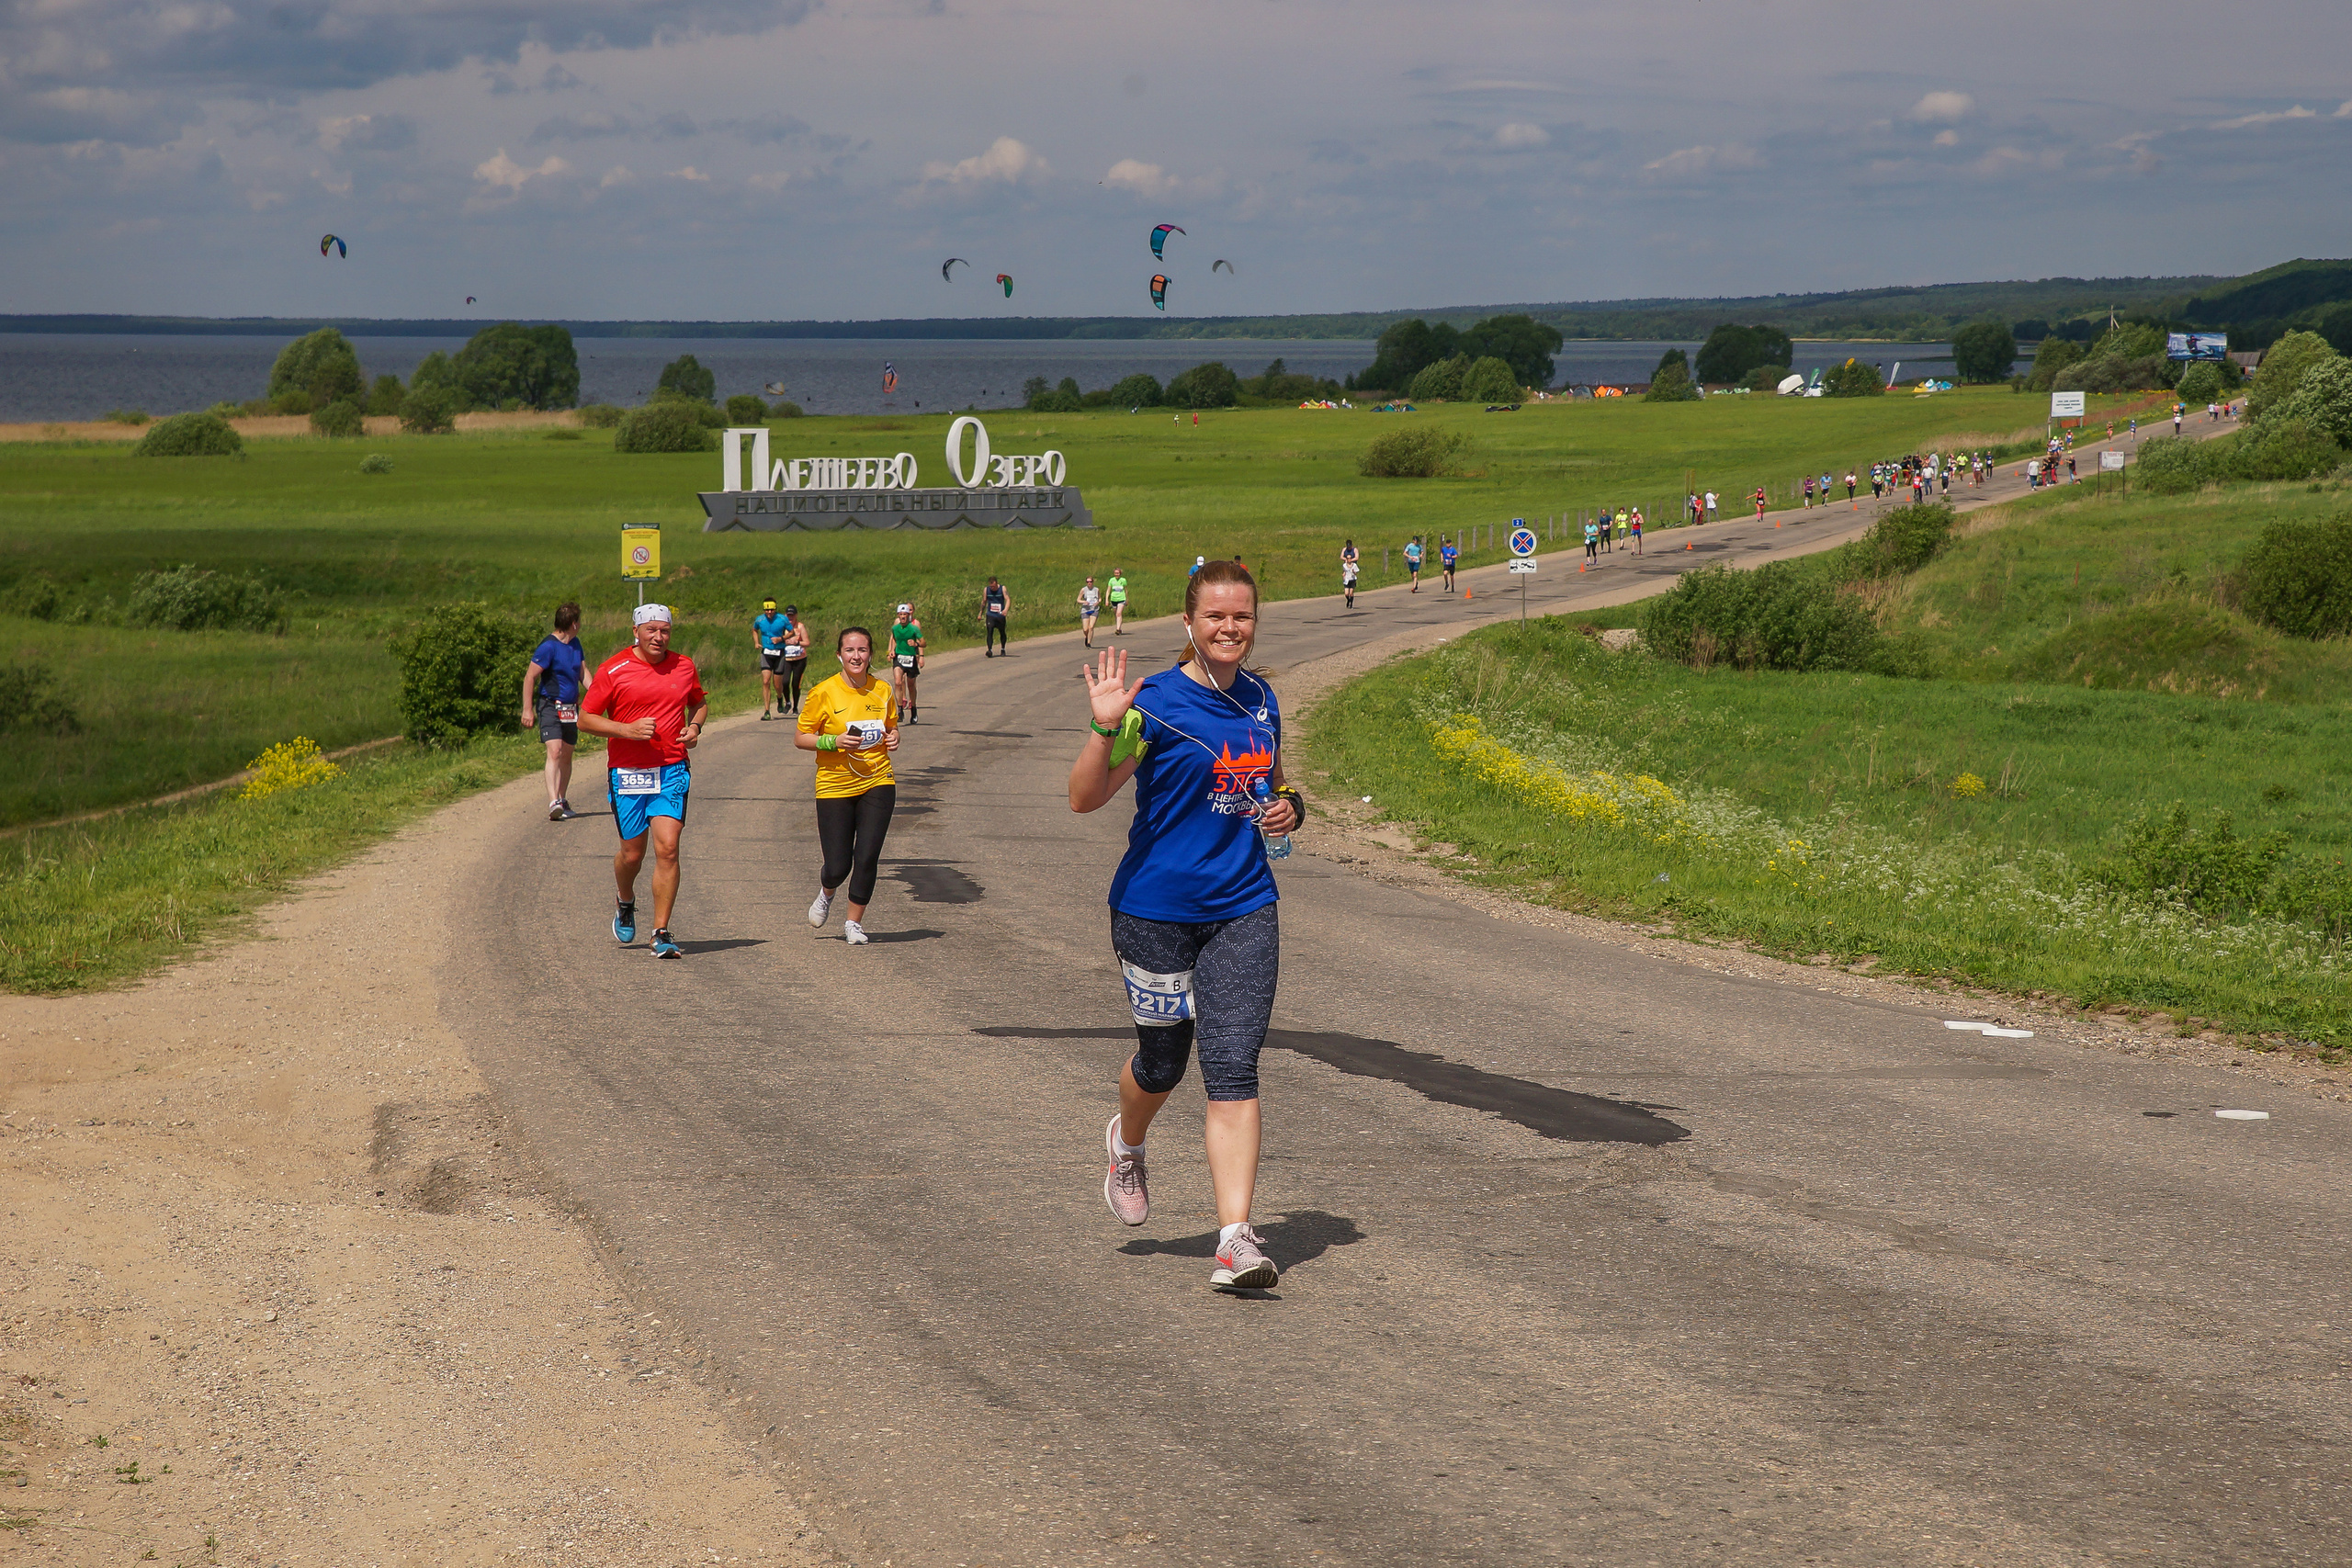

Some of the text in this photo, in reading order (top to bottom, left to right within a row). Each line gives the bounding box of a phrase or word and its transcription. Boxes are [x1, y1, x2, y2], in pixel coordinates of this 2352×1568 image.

[999, 491, 1065, 509] ПАРК
[861, 730, 878, 741] 661
[621, 774, 652, 784] 3652
[1213, 774, 1230, 793] 5
[1216, 793, 1244, 803] ЦЕНТРЕ
[1211, 800, 1254, 814] МОСКВЫ
[1174, 980, 1181, 991] B
[1129, 986, 1182, 1015] 3217
